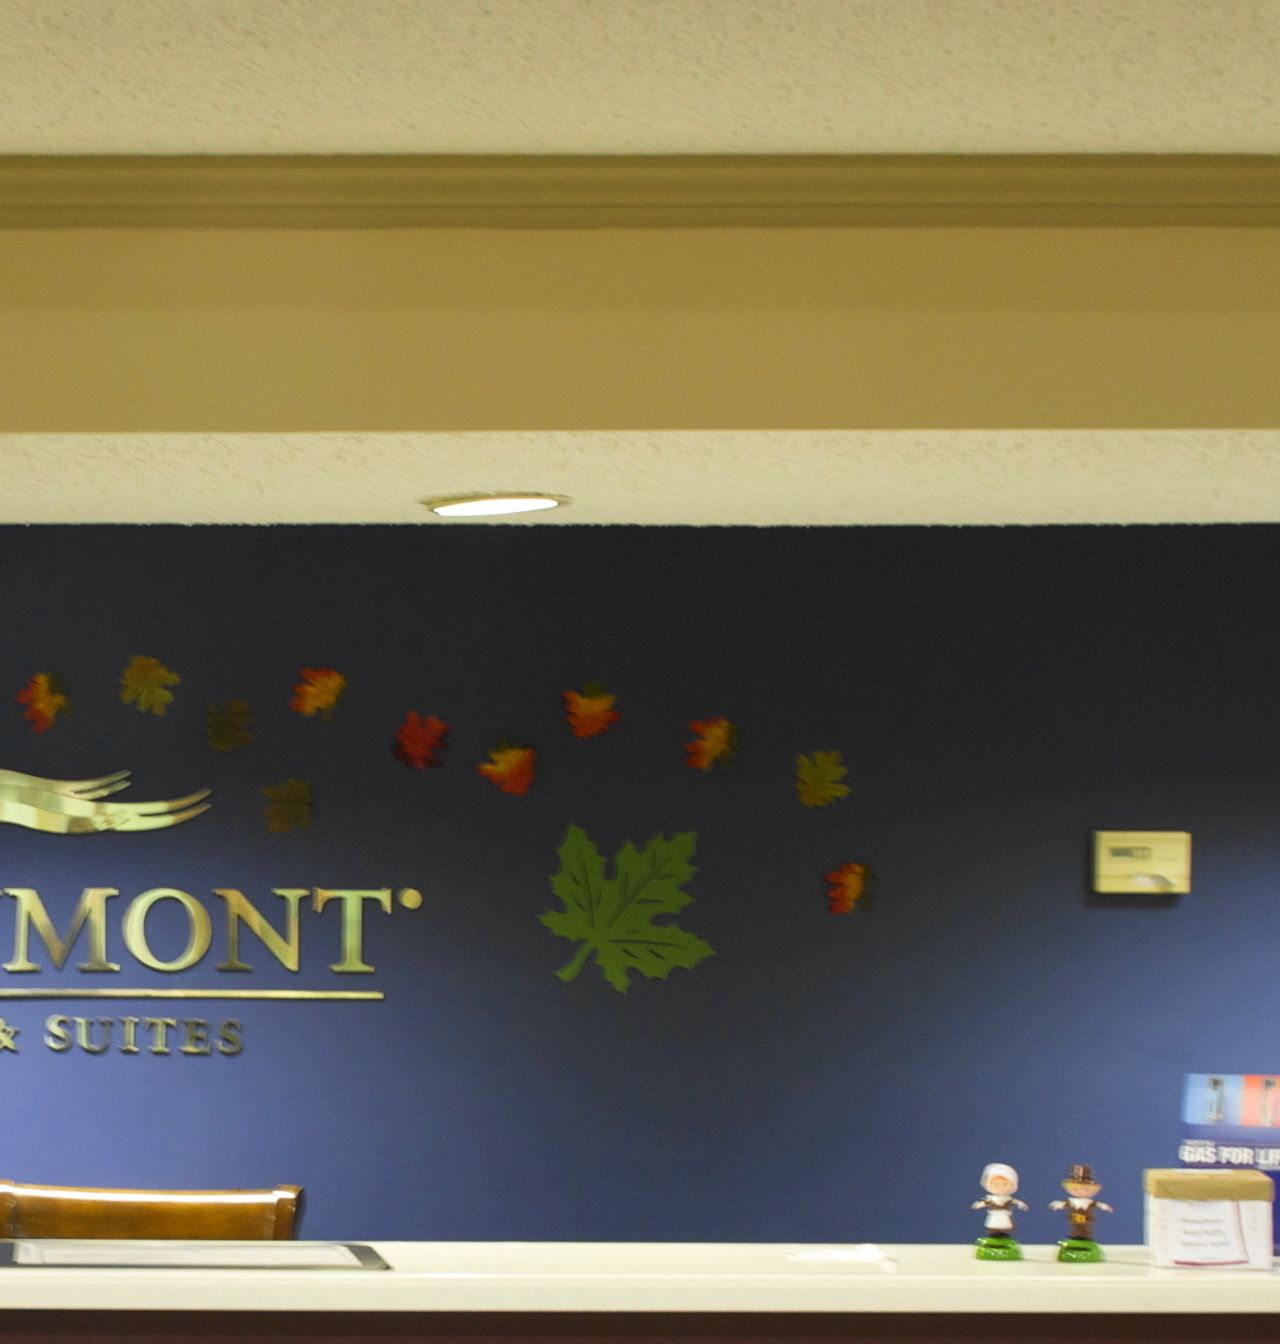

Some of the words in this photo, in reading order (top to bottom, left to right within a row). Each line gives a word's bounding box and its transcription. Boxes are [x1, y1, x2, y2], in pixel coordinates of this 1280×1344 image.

[44, 1016, 243, 1055] SUITES
[1179, 1145, 1217, 1164] GAS
[1219, 1147, 1254, 1165] FOR
